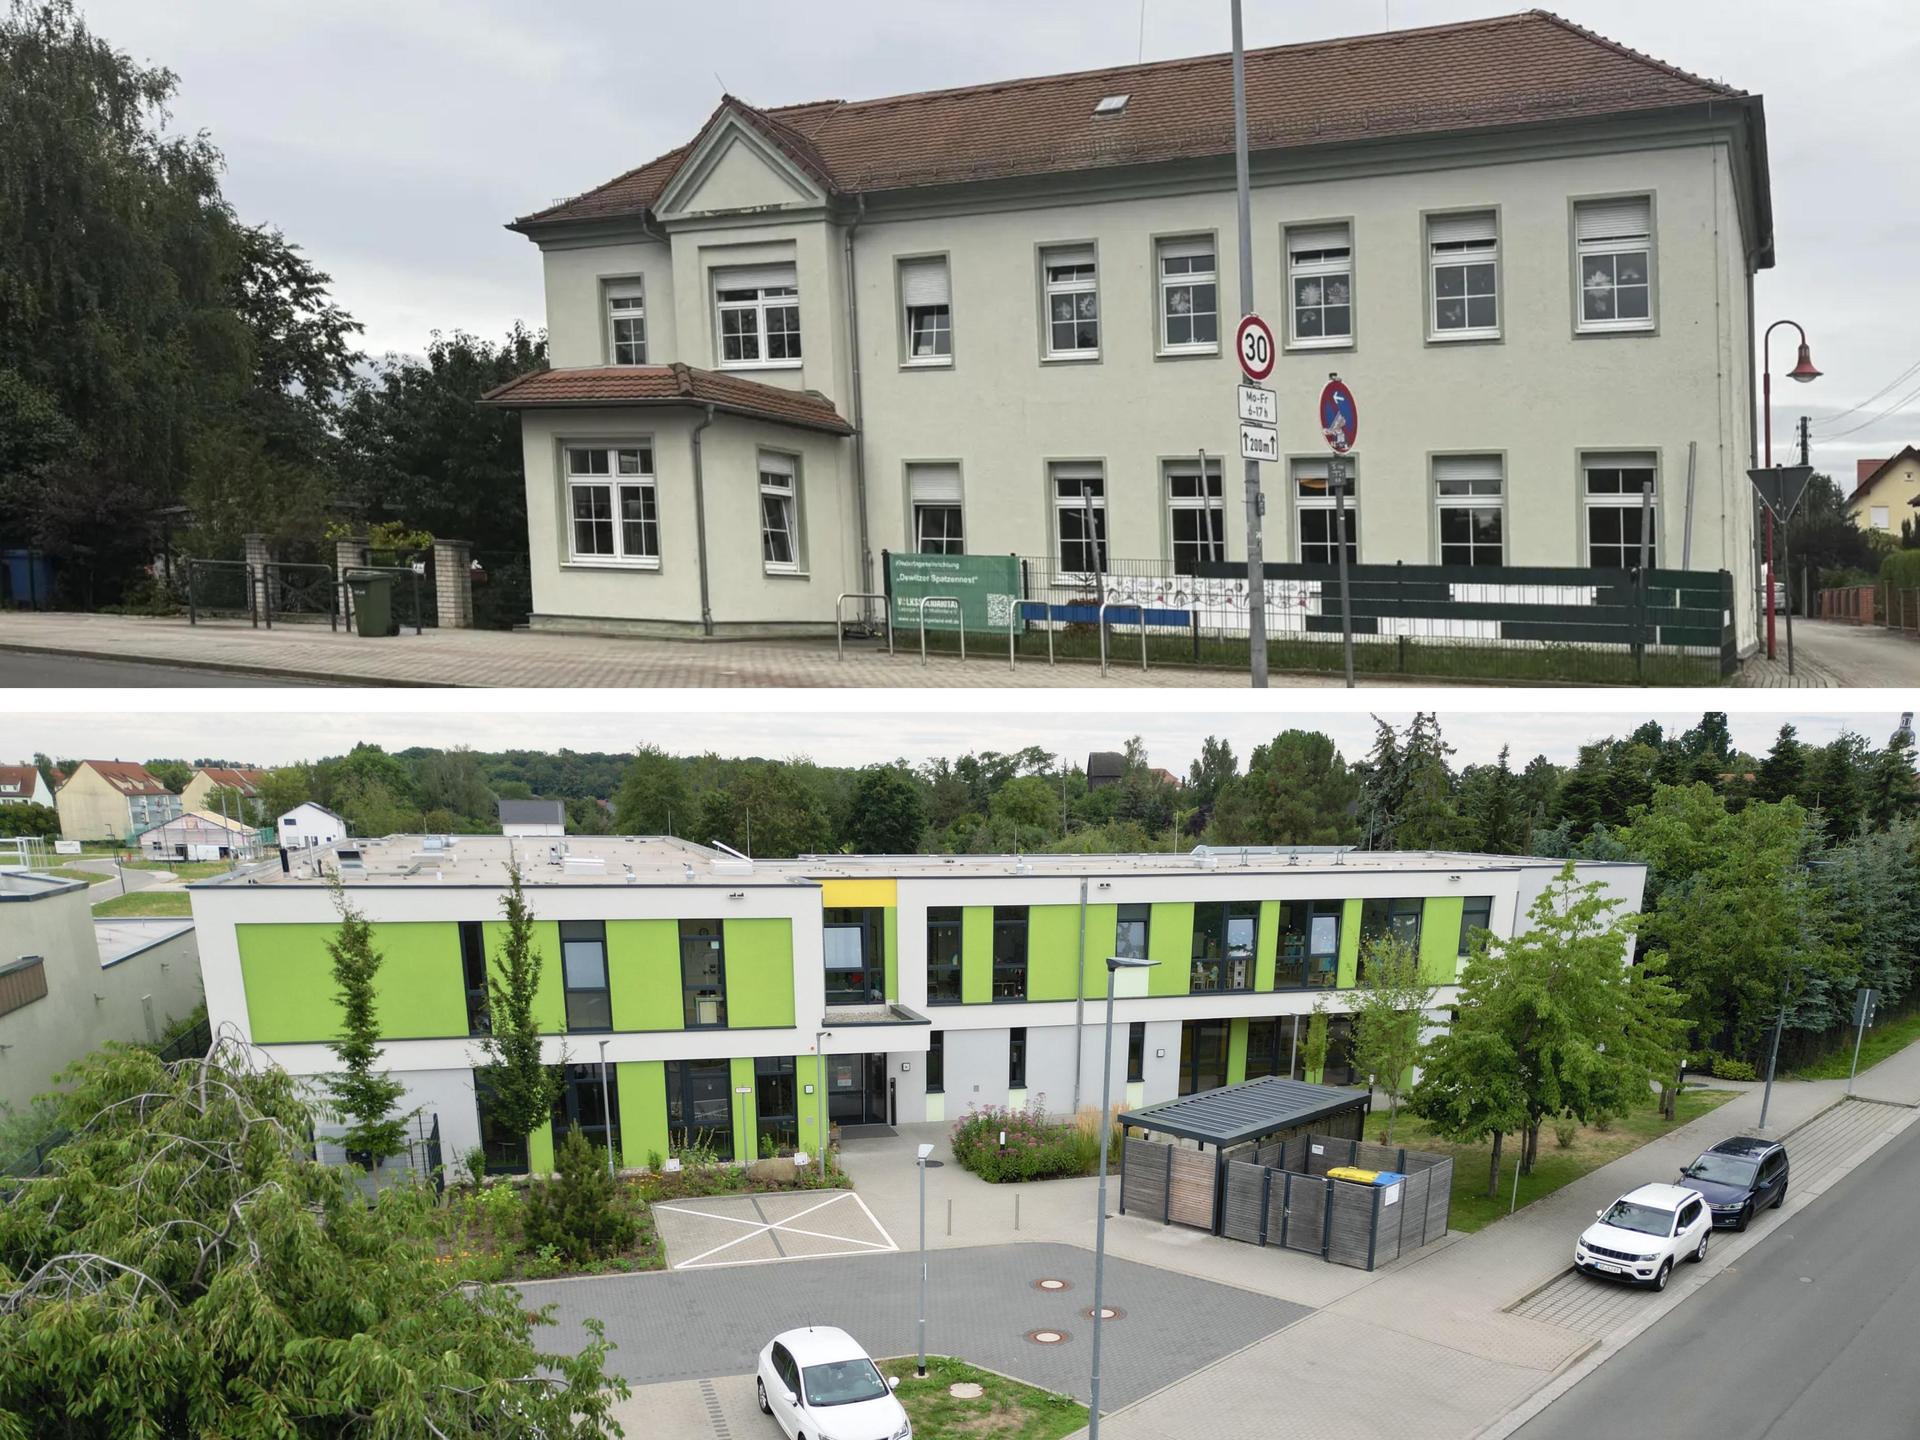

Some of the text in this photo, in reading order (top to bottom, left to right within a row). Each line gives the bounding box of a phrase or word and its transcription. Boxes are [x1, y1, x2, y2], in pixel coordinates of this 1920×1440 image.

[1245, 333, 1267, 363] 30
[1246, 391, 1268, 404] Mo-Fr
[1248, 406, 1263, 416] 6-17
